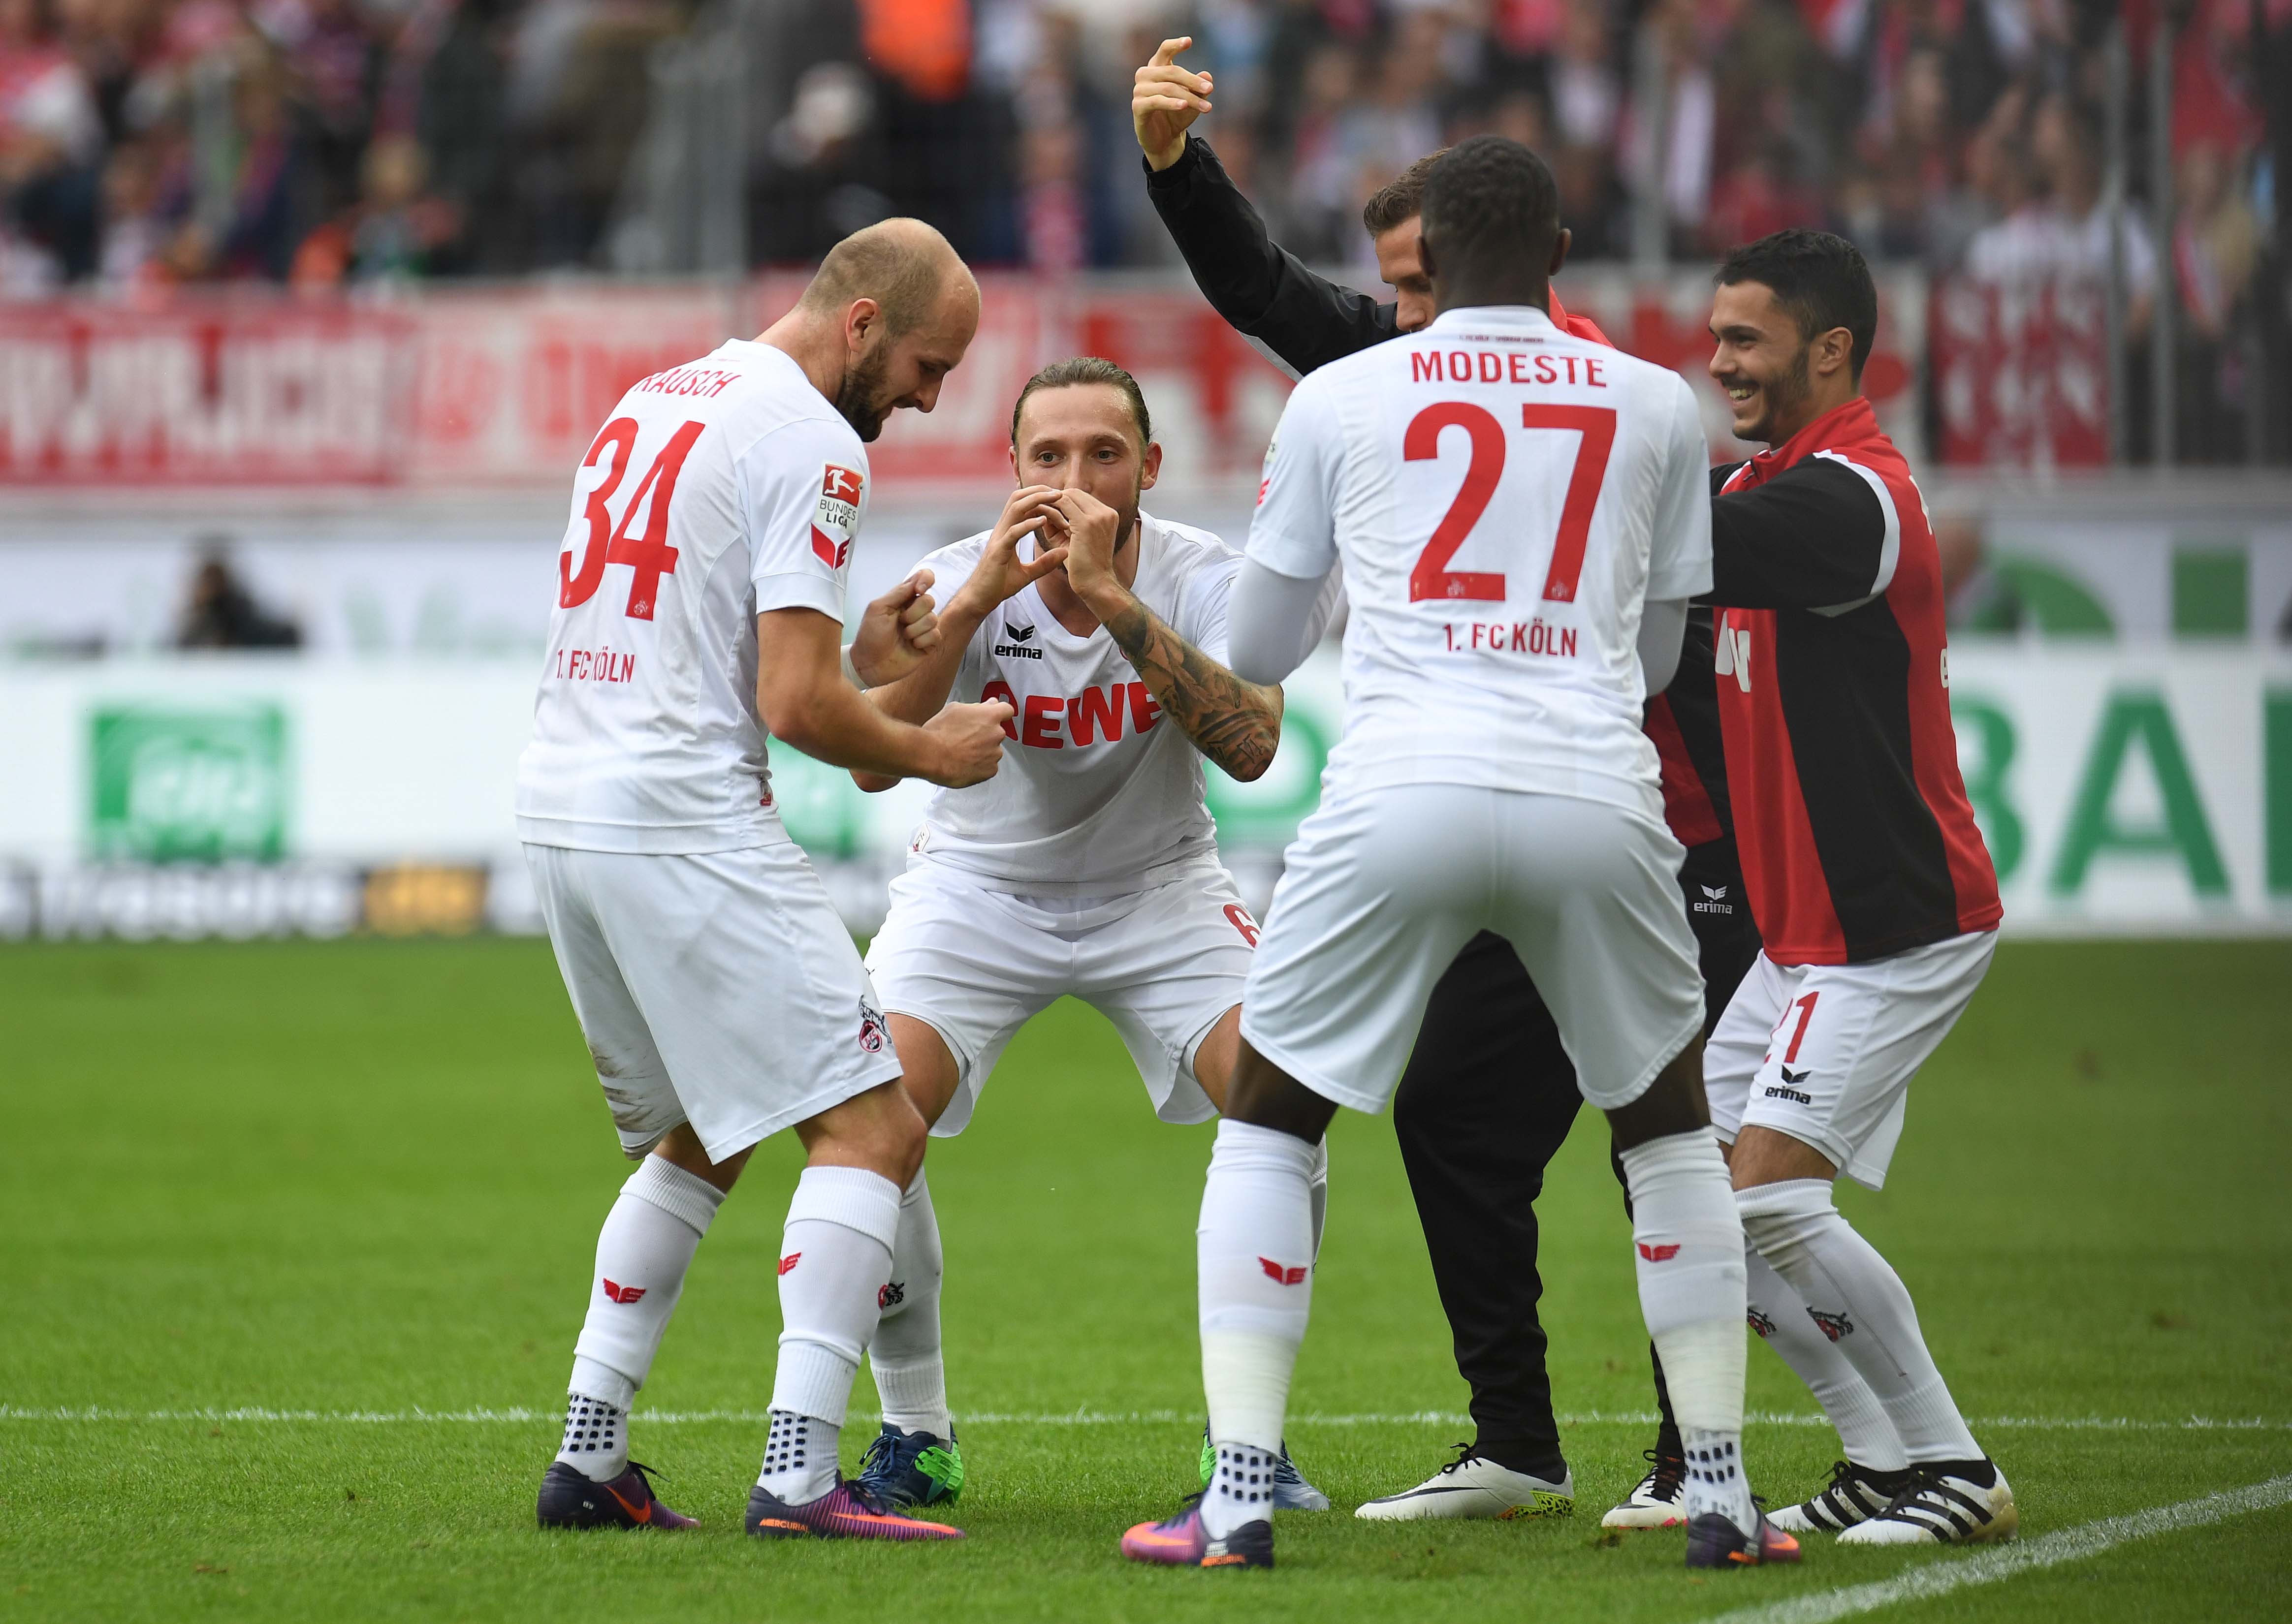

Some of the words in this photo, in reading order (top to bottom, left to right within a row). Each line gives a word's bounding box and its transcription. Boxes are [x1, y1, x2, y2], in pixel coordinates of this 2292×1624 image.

[634, 369, 742, 398] RAUSCH
[1411, 351, 1607, 387] MODESTE
[820, 500, 857, 521] BUNDES
[1404, 401, 1617, 603] 27
[559, 417, 706, 621] 34
[826, 512, 848, 529] LIGA
[1442, 623, 1461, 652] 1.
[1471, 623, 1504, 650] FC
[1511, 617, 1577, 657] KÖLN
[557, 649, 563, 679] 1.
[569, 650, 591, 680] FC
[591, 646, 635, 683] KÖLN
[994, 644, 1043, 660] erima
[1693, 900, 1733, 915] erima
[1765, 1086, 1812, 1105] erima
